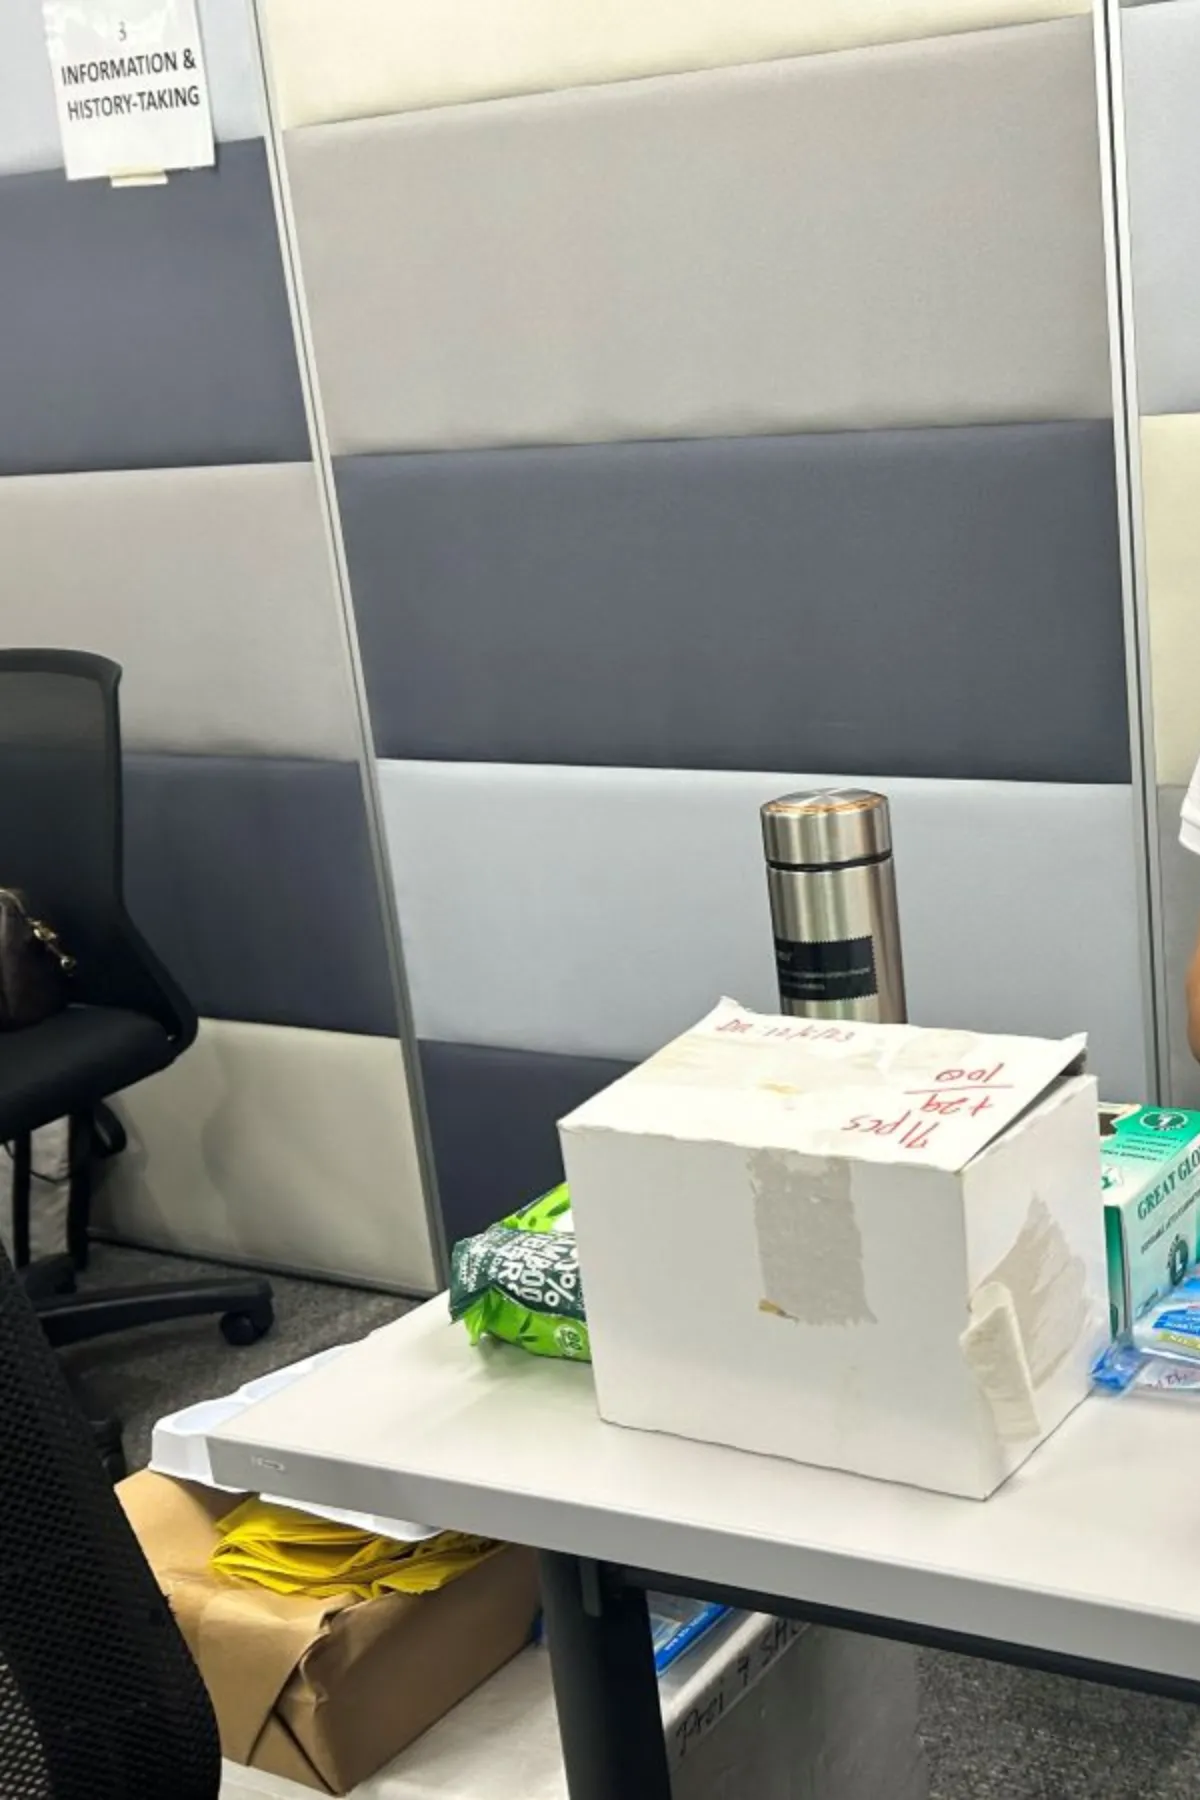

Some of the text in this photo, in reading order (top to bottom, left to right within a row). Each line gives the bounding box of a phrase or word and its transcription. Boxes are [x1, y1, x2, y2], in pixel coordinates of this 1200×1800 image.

[61, 47, 197, 86] INFORMATION &
[66, 85, 201, 121] HISTORY-TAKING
[934, 1062, 1005, 1083] 100
[1137, 1170, 1177, 1220] GREAT
